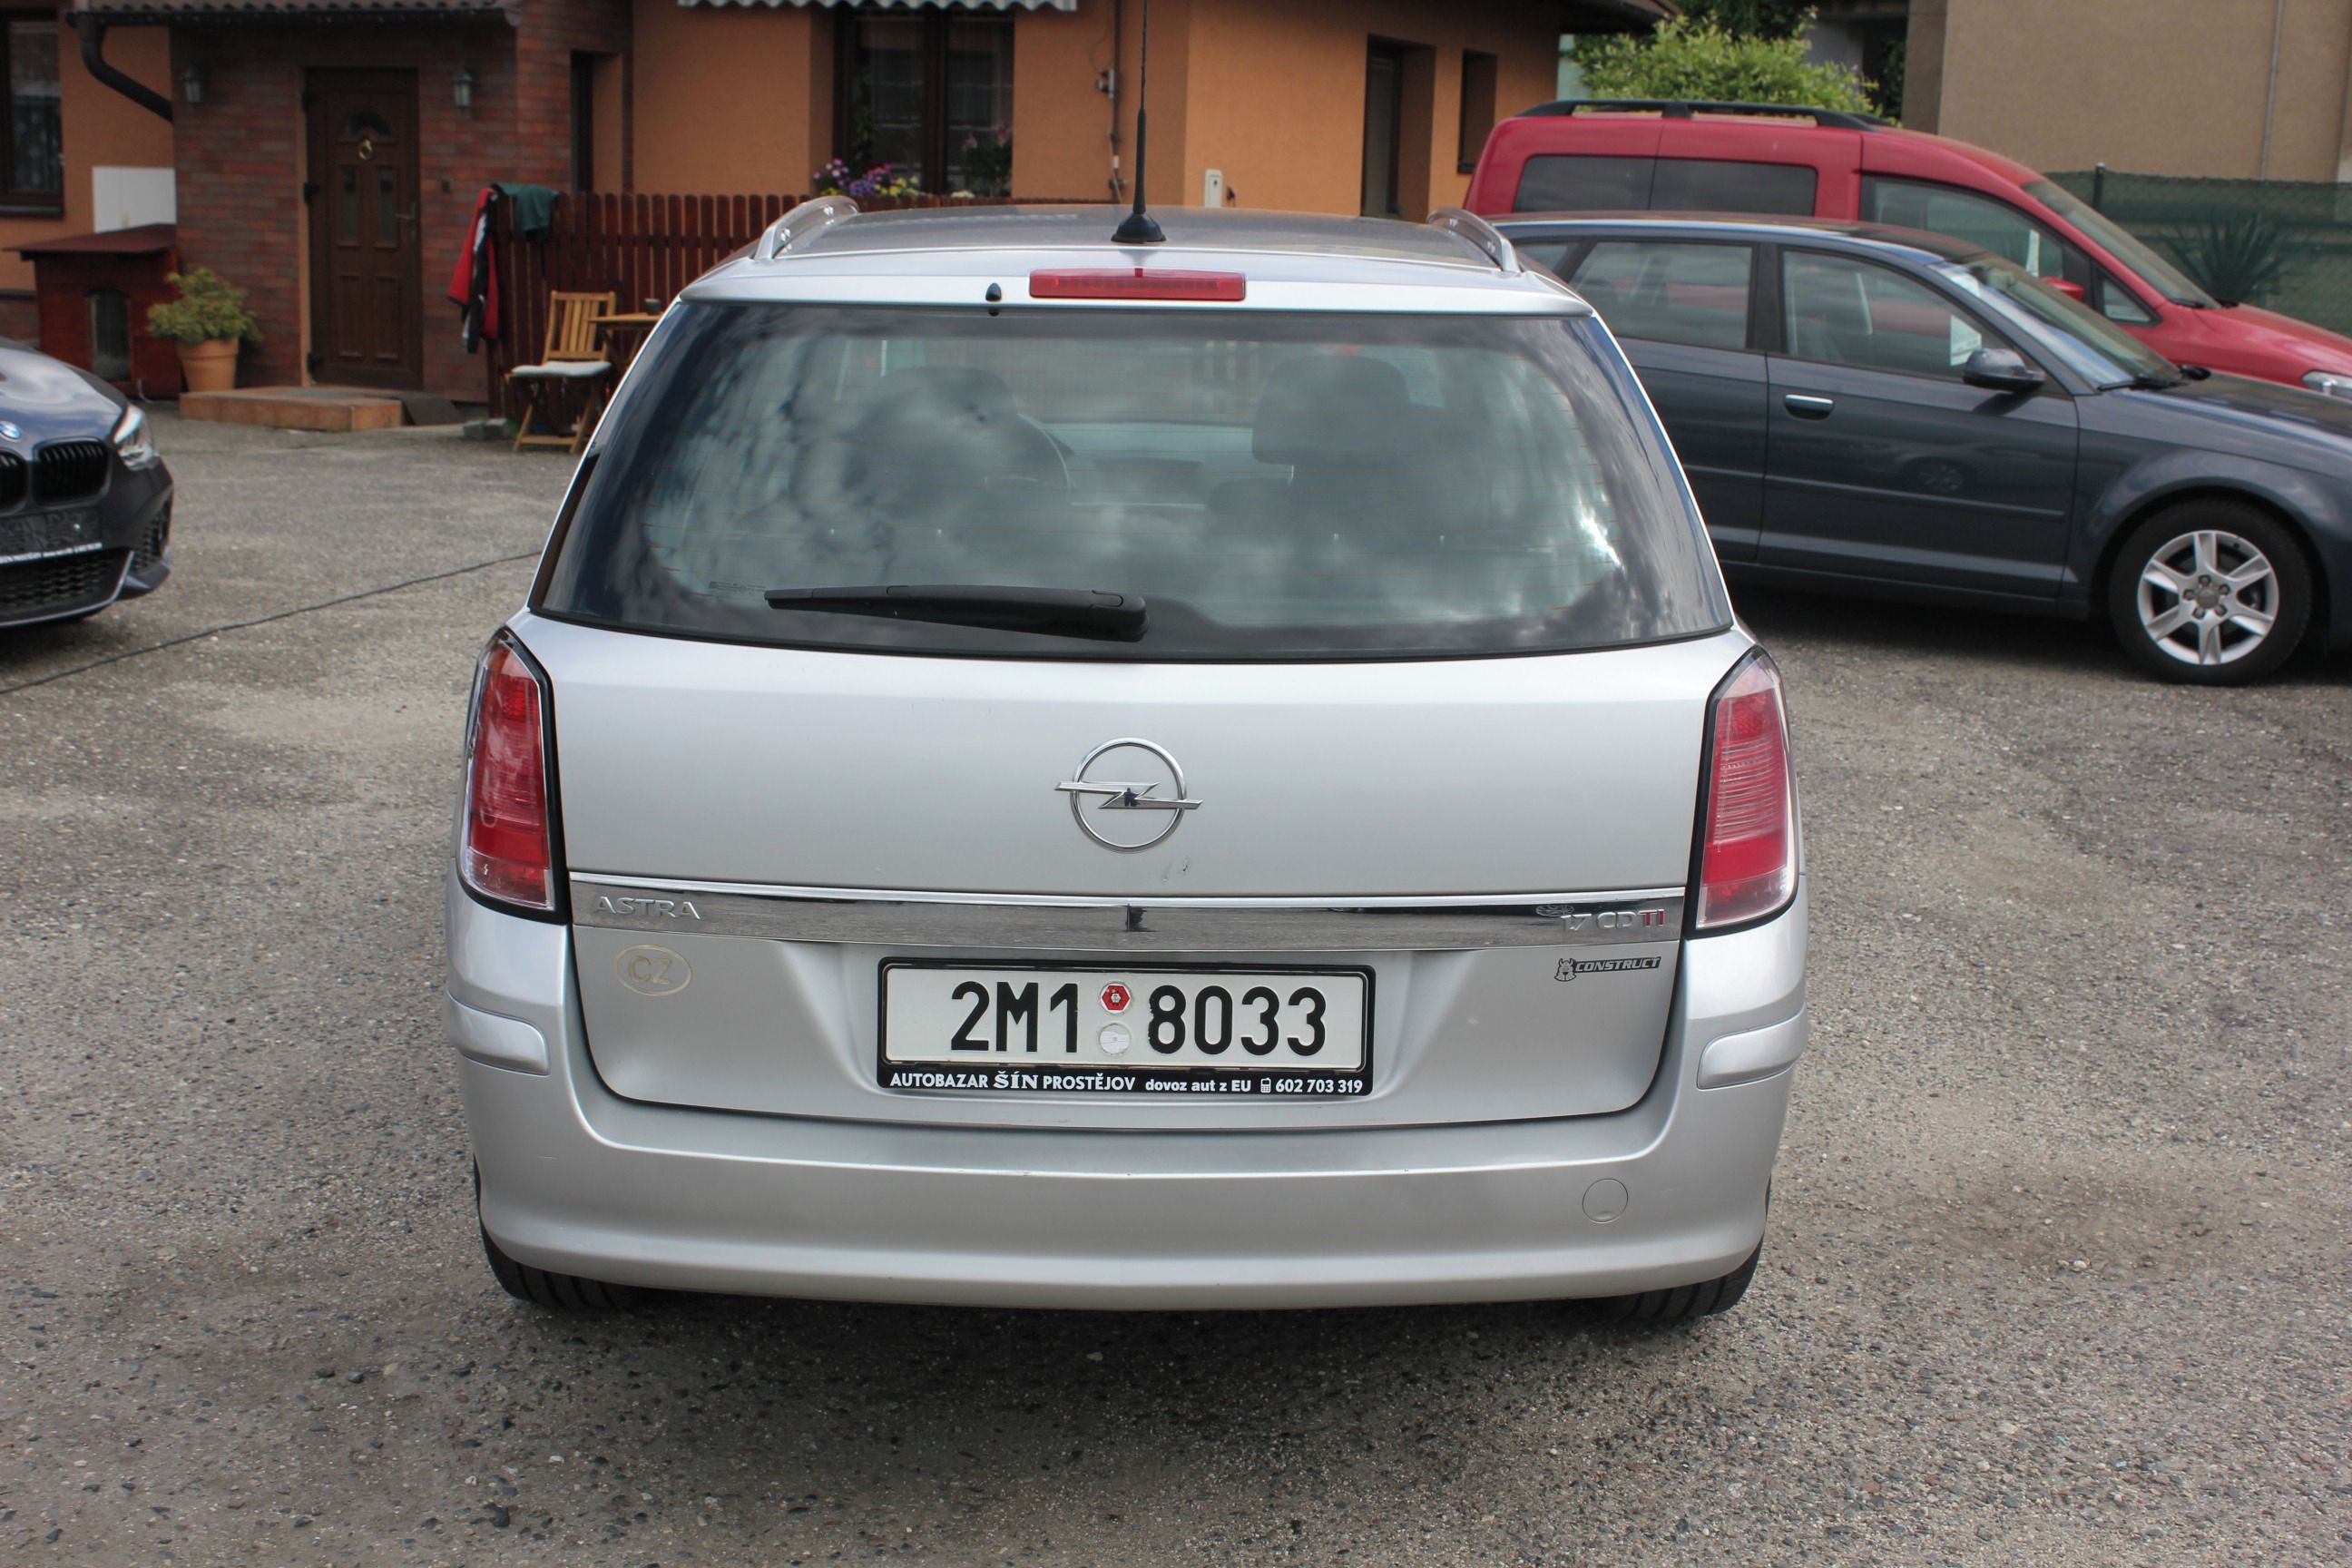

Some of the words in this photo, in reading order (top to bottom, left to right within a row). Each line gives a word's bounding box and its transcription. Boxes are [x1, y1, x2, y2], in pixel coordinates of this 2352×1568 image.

[595, 895, 701, 920] ASTRA
[627, 955, 672, 985] CZ
[1575, 957, 1661, 972] CONSTRUCT
[951, 980, 1078, 1053] 2M1
[1148, 985, 1327, 1056] 8033
[889, 1073, 988, 1088] AUTOBAZAR
[993, 1070, 1039, 1089] ŠÍN
[1043, 1073, 1136, 1091] PROSTĚJOV
[1145, 1079, 1188, 1092] dovoz
[1191, 1080, 1216, 1092] aut
[1219, 1083, 1228, 1092] z
[1231, 1080, 1251, 1093] EU
[1275, 1079, 1303, 1093] 602
[1307, 1079, 1334, 1093] 703
[1338, 1079, 1363, 1093] 319
